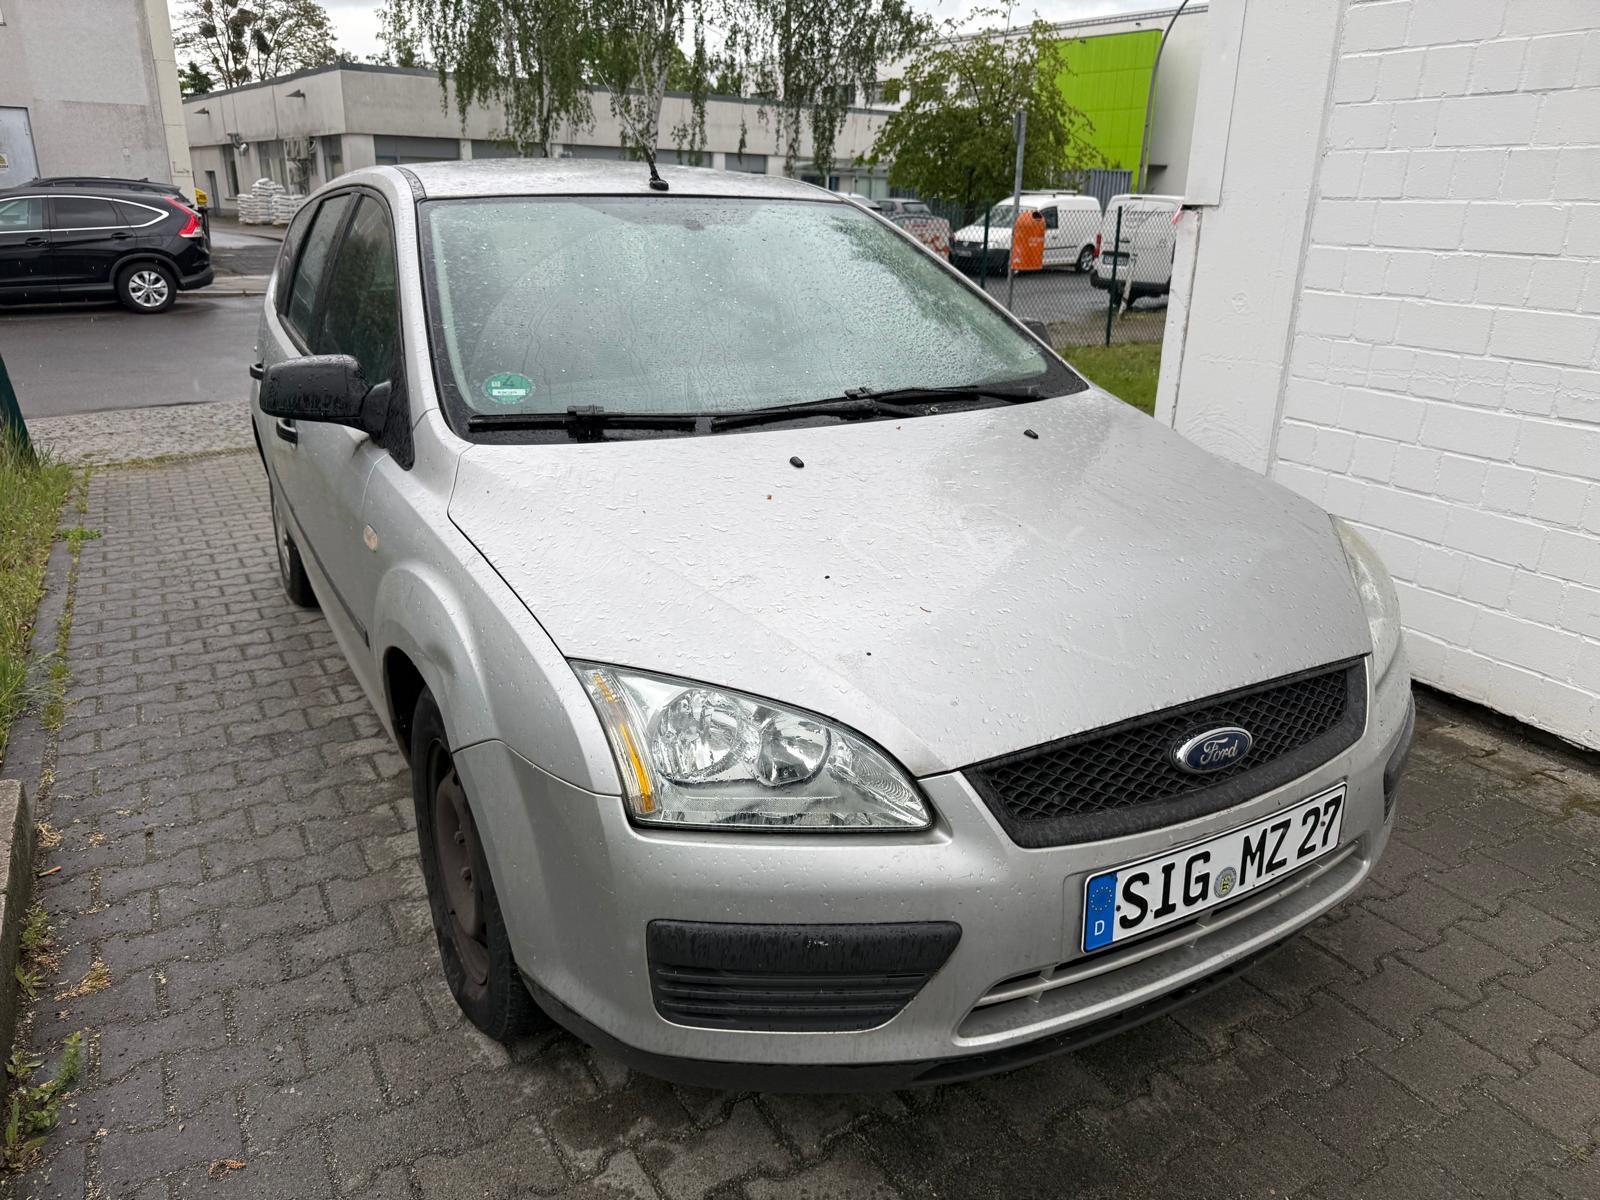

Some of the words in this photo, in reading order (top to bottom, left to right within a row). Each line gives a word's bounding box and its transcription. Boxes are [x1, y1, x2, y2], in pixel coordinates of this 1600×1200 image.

[1200, 737, 1238, 765] Ford
[1119, 851, 1211, 929] SIG
[1239, 818, 1291, 886] MZ
[1297, 794, 1342, 860] 27
[1094, 920, 1105, 936] D
